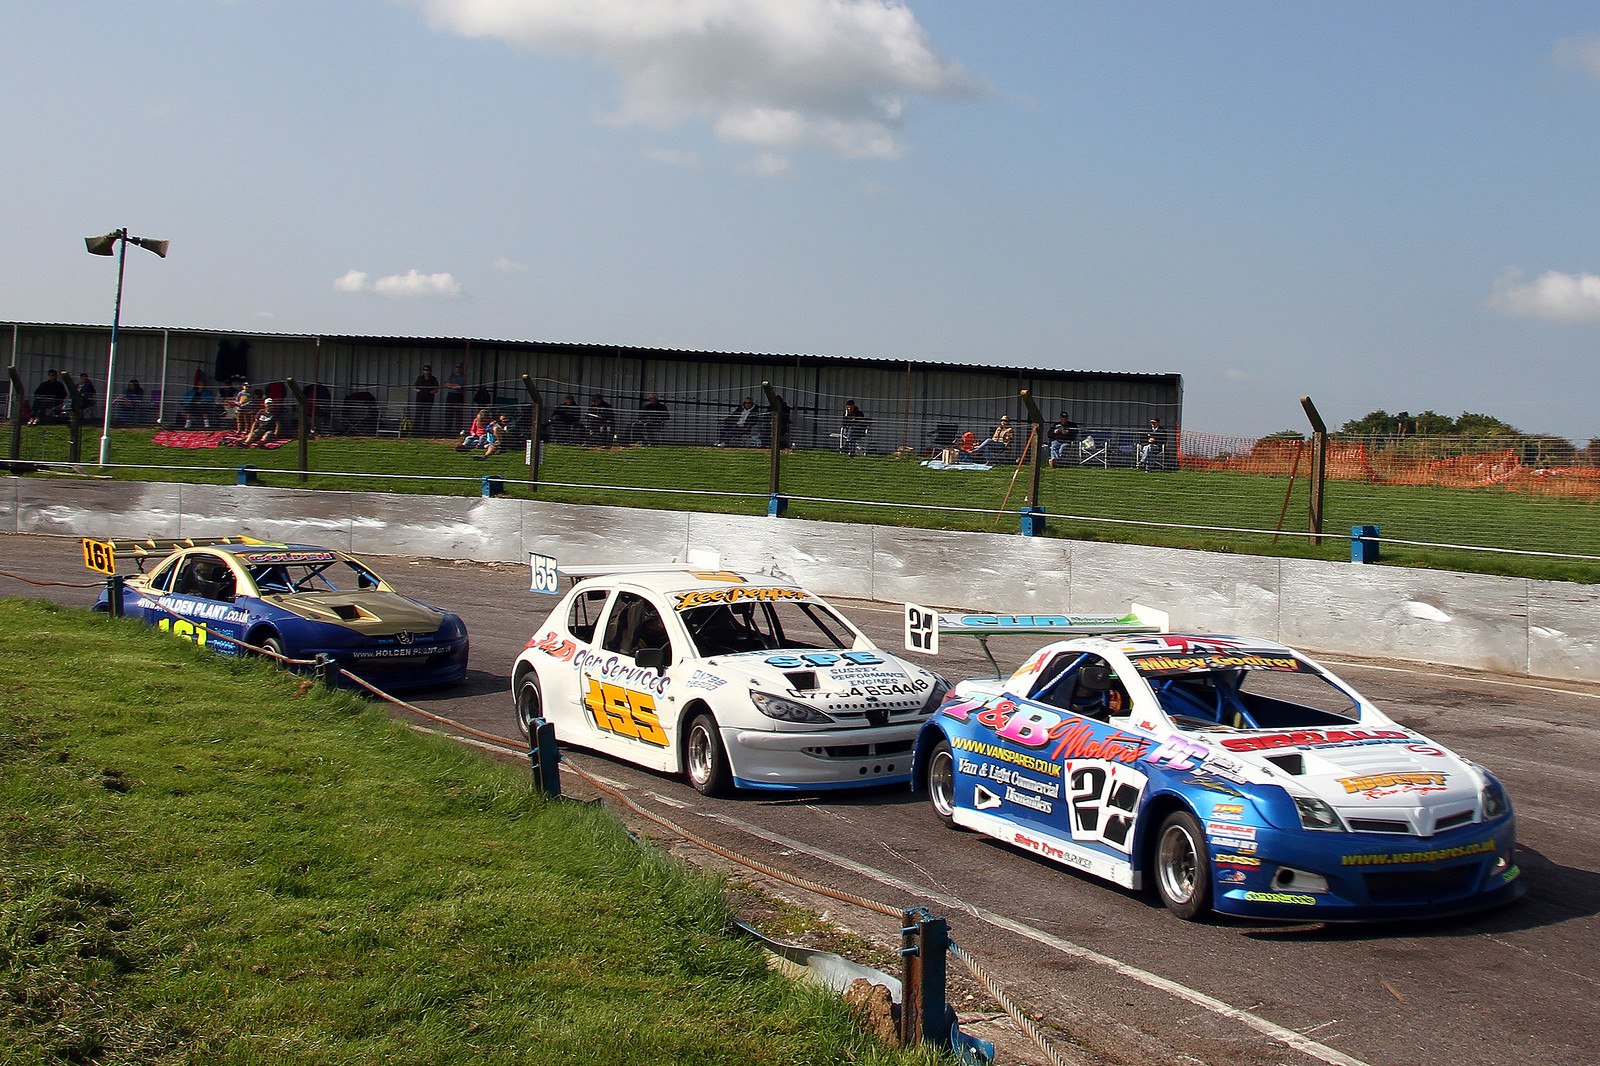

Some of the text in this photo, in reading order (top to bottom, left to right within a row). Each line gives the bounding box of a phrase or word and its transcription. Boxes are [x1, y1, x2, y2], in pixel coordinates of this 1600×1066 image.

[85, 542, 114, 574] 161
[530, 554, 558, 591] 155
[674, 593, 724, 611] Lee
[573, 650, 671, 695] Car Services
[1137, 656, 1207, 671] Mikey
[584, 679, 670, 747] 155
[1049, 717, 1152, 763] Motors
[958, 757, 978, 776] Van
[979, 763, 988, 777] &
[988, 764, 1012, 784] Light
